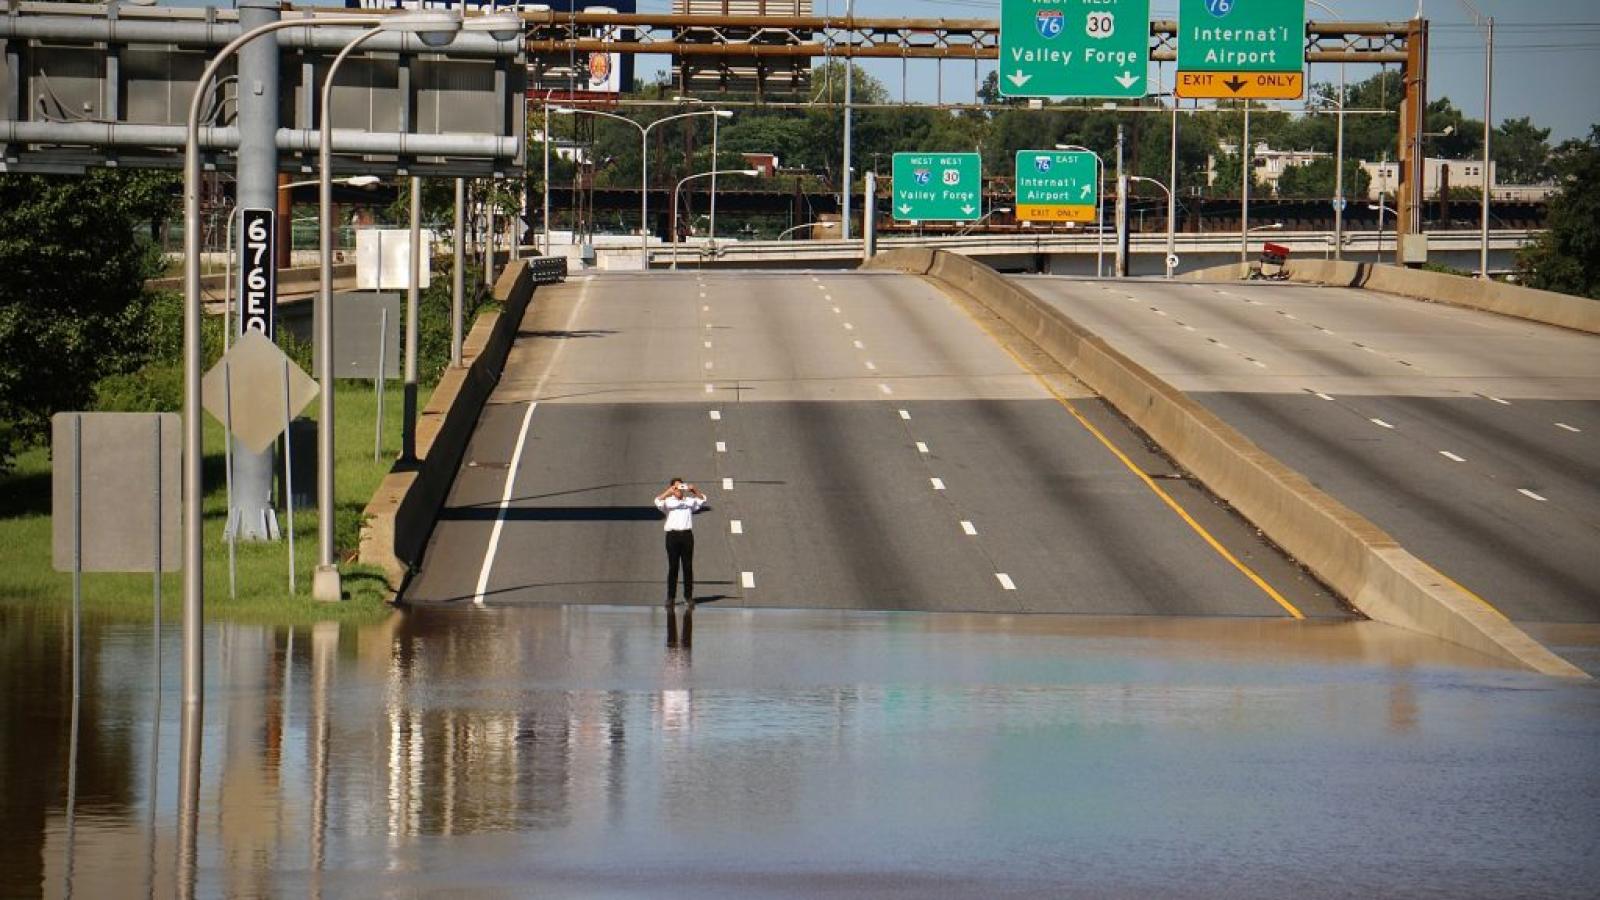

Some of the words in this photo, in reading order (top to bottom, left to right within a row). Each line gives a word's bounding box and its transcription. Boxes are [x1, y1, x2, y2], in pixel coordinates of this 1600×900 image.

[1038, 18, 1060, 33] 76
[1088, 16, 1112, 32] 30
[1194, 26, 1288, 42] Internat'l
[1011, 47, 1072, 65] Valley
[1085, 48, 1137, 66] Forge
[1204, 48, 1276, 66] Airport
[1183, 74, 1214, 85] EXIT
[1257, 75, 1296, 86] ONLY
[910, 157, 933, 165] WEST
[940, 157, 963, 165] WEST
[1055, 155, 1079, 163] EAST
[1038, 160, 1050, 170] 76
[914, 172, 929, 182] 76
[944, 172, 958, 182] 30
[899, 190, 935, 201] Valley
[943, 190, 974, 202] Forge
[1027, 190, 1069, 200] Airport
[1031, 208, 1050, 217] EXIT
[1057, 209, 1080, 217] ONLY
